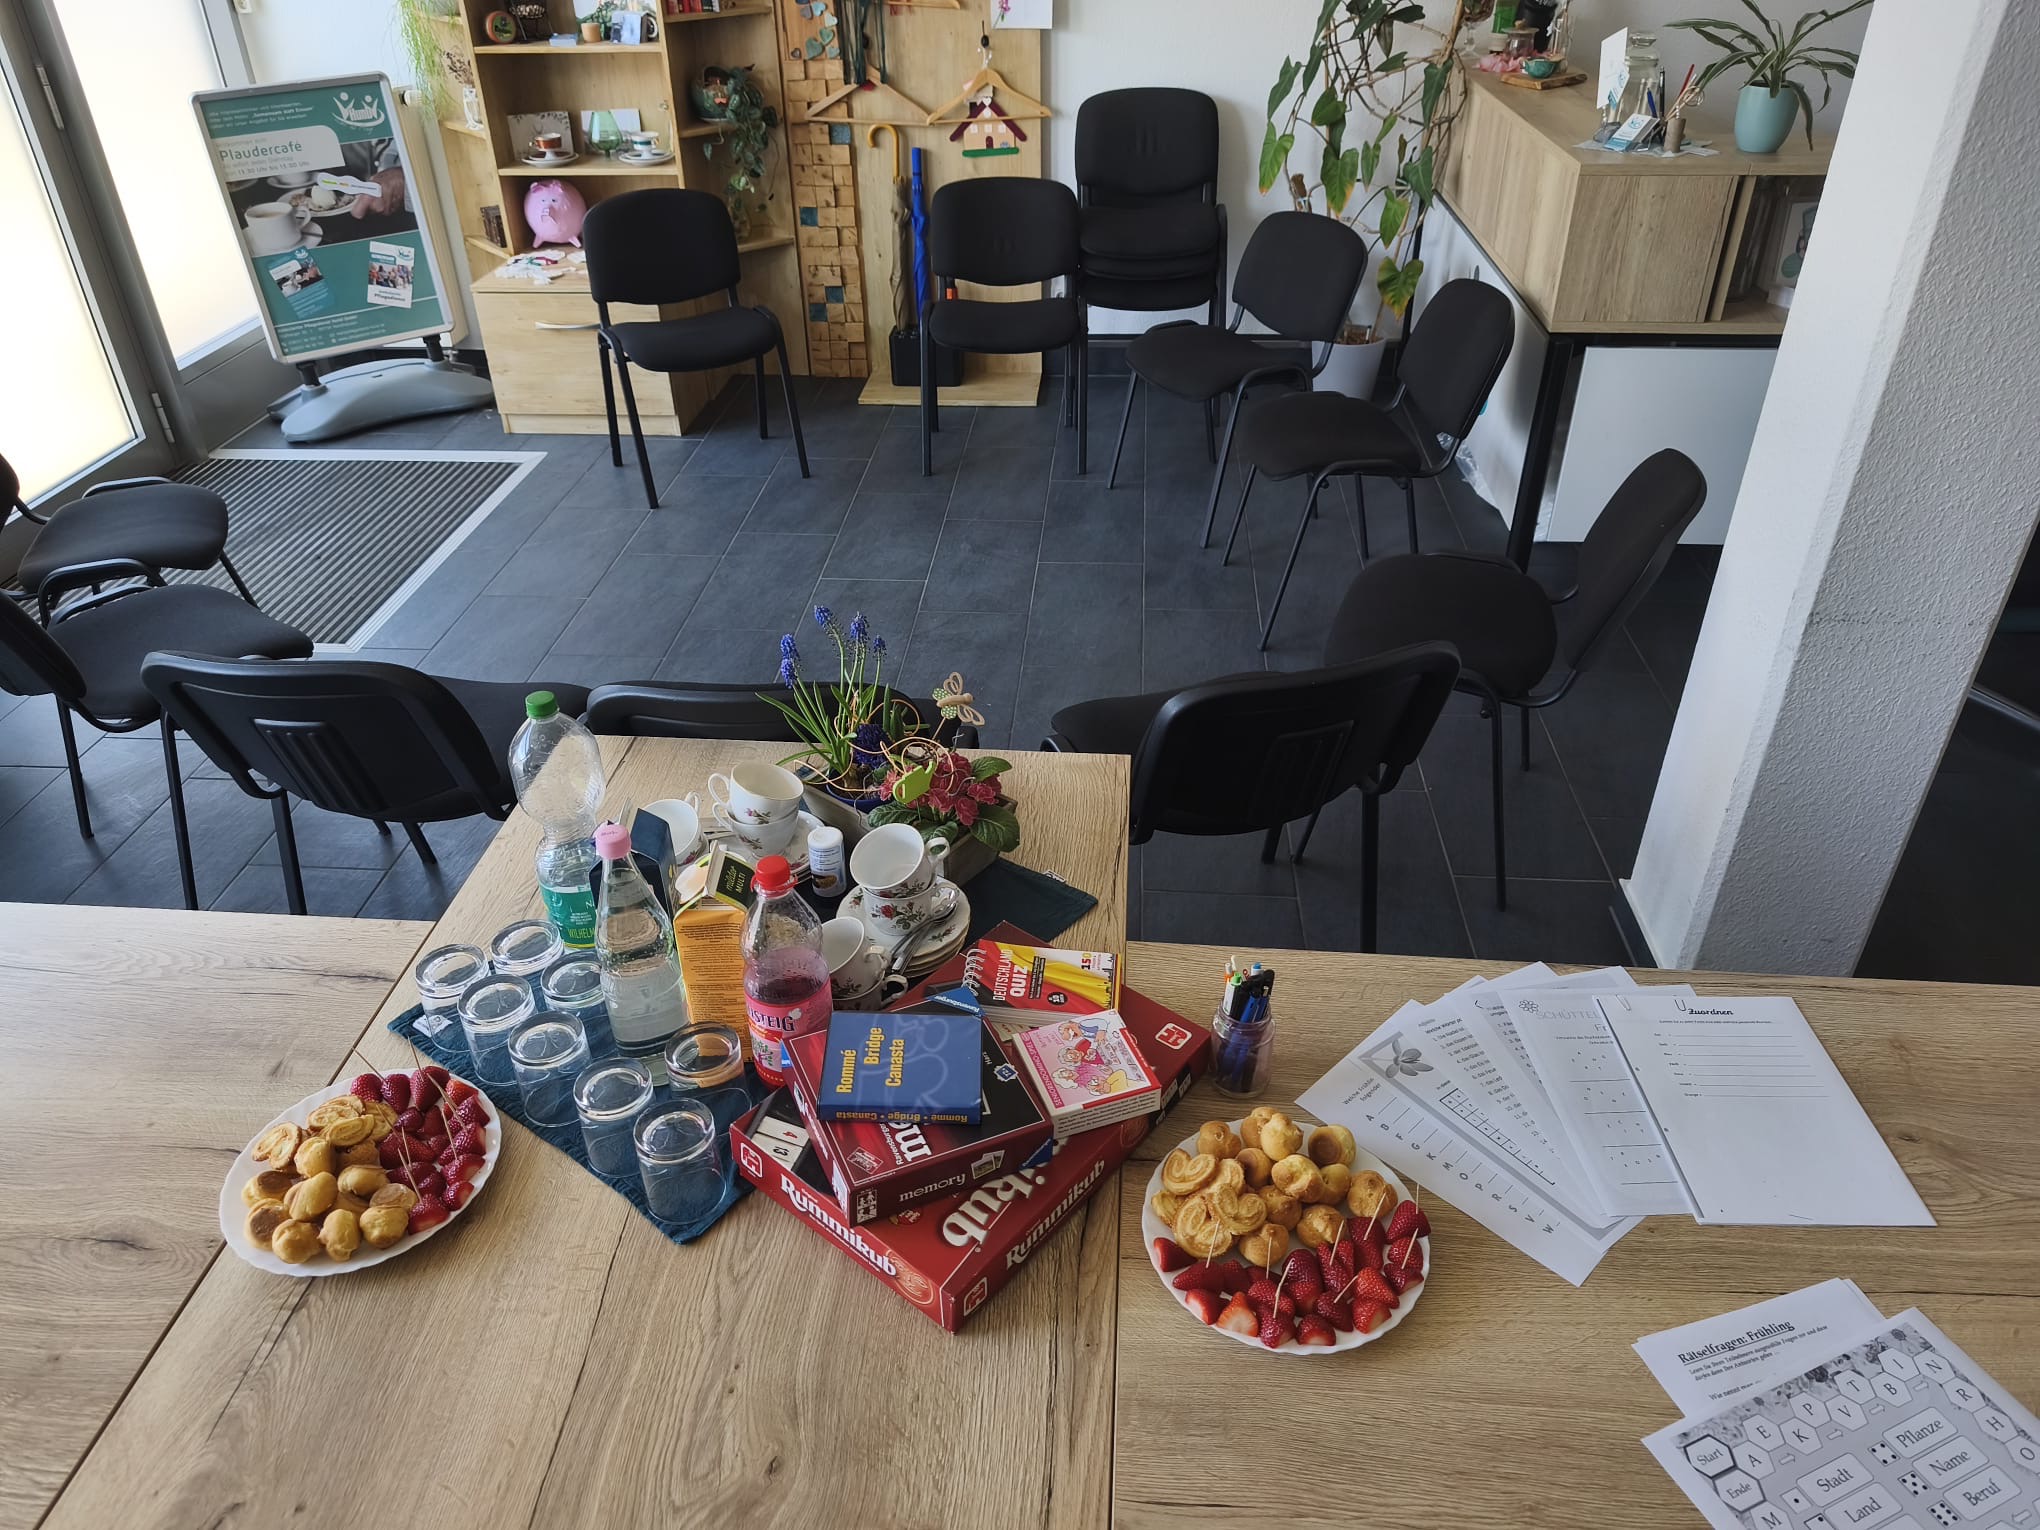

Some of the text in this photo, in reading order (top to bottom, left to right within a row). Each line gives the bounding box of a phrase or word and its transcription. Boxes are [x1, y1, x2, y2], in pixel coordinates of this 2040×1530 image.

[735, 872, 746, 893] MULTI
[1081, 952, 1093, 970] 150
[992, 949, 1015, 1001] DEUTSCHLAND
[1010, 965, 1029, 997] QUIZ
[933, 995, 980, 1012] Ravensburger
[1688, 1008, 1734, 1016] Zuordnen
[864, 1027, 885, 1065] Bridge
[885, 1039, 905, 1087] Canasta
[836, 1049, 857, 1094] Rommé
[836, 1111, 878, 1121] Canasta
[888, 1111, 921, 1121] Bridge
[1365, 1114, 1375, 1122] A
[1380, 1123, 1390, 1131] B
[1395, 1132, 1404, 1140] F
[1411, 1142, 1420, 1150] G
[1426, 1152, 1436, 1160] K
[1442, 1162, 1454, 1171] M
[1459, 1172, 1469, 1181] O
[900, 1173, 966, 1202] memory
[1475, 1183, 1484, 1191] P
[1491, 1193, 1502, 1202] R
[1006, 1160, 1105, 1271] Rummikub
[1508, 1204, 1518, 1213] S
[780, 1173, 897, 1276] Rummikub
[1524, 1215, 1535, 1224] V
[1542, 1224, 1554, 1234] W
[1678, 1320, 1795, 1364] Rätselfragen: Frühling
[1926, 1360, 1943, 1374] N
[1846, 1379, 1862, 1393] T
[1883, 1383, 1898, 1395] B
[1956, 1388, 1973, 1402] R
[1802, 1402, 1814, 1416] P
[1838, 1405, 1853, 1419] V
[1986, 1416, 2005, 1432] H
[1756, 1425, 1772, 1439] E
[1792, 1429, 1810, 1443] K
[1896, 1419, 1944, 1448] Pflanze
[1696, 1448, 1724, 1466] Start
[1748, 1454, 1763, 1468] A
[2020, 1448, 2035, 1461] O
[1929, 1450, 1972, 1477] Name
[1816, 1467, 1855, 1493] Stadt
[1726, 1482, 1752, 1500] Ende
[1963, 1478, 2002, 1507] Beruf
[1844, 1497, 1883, 1524] Land
[1761, 1511, 1783, 1530] M
